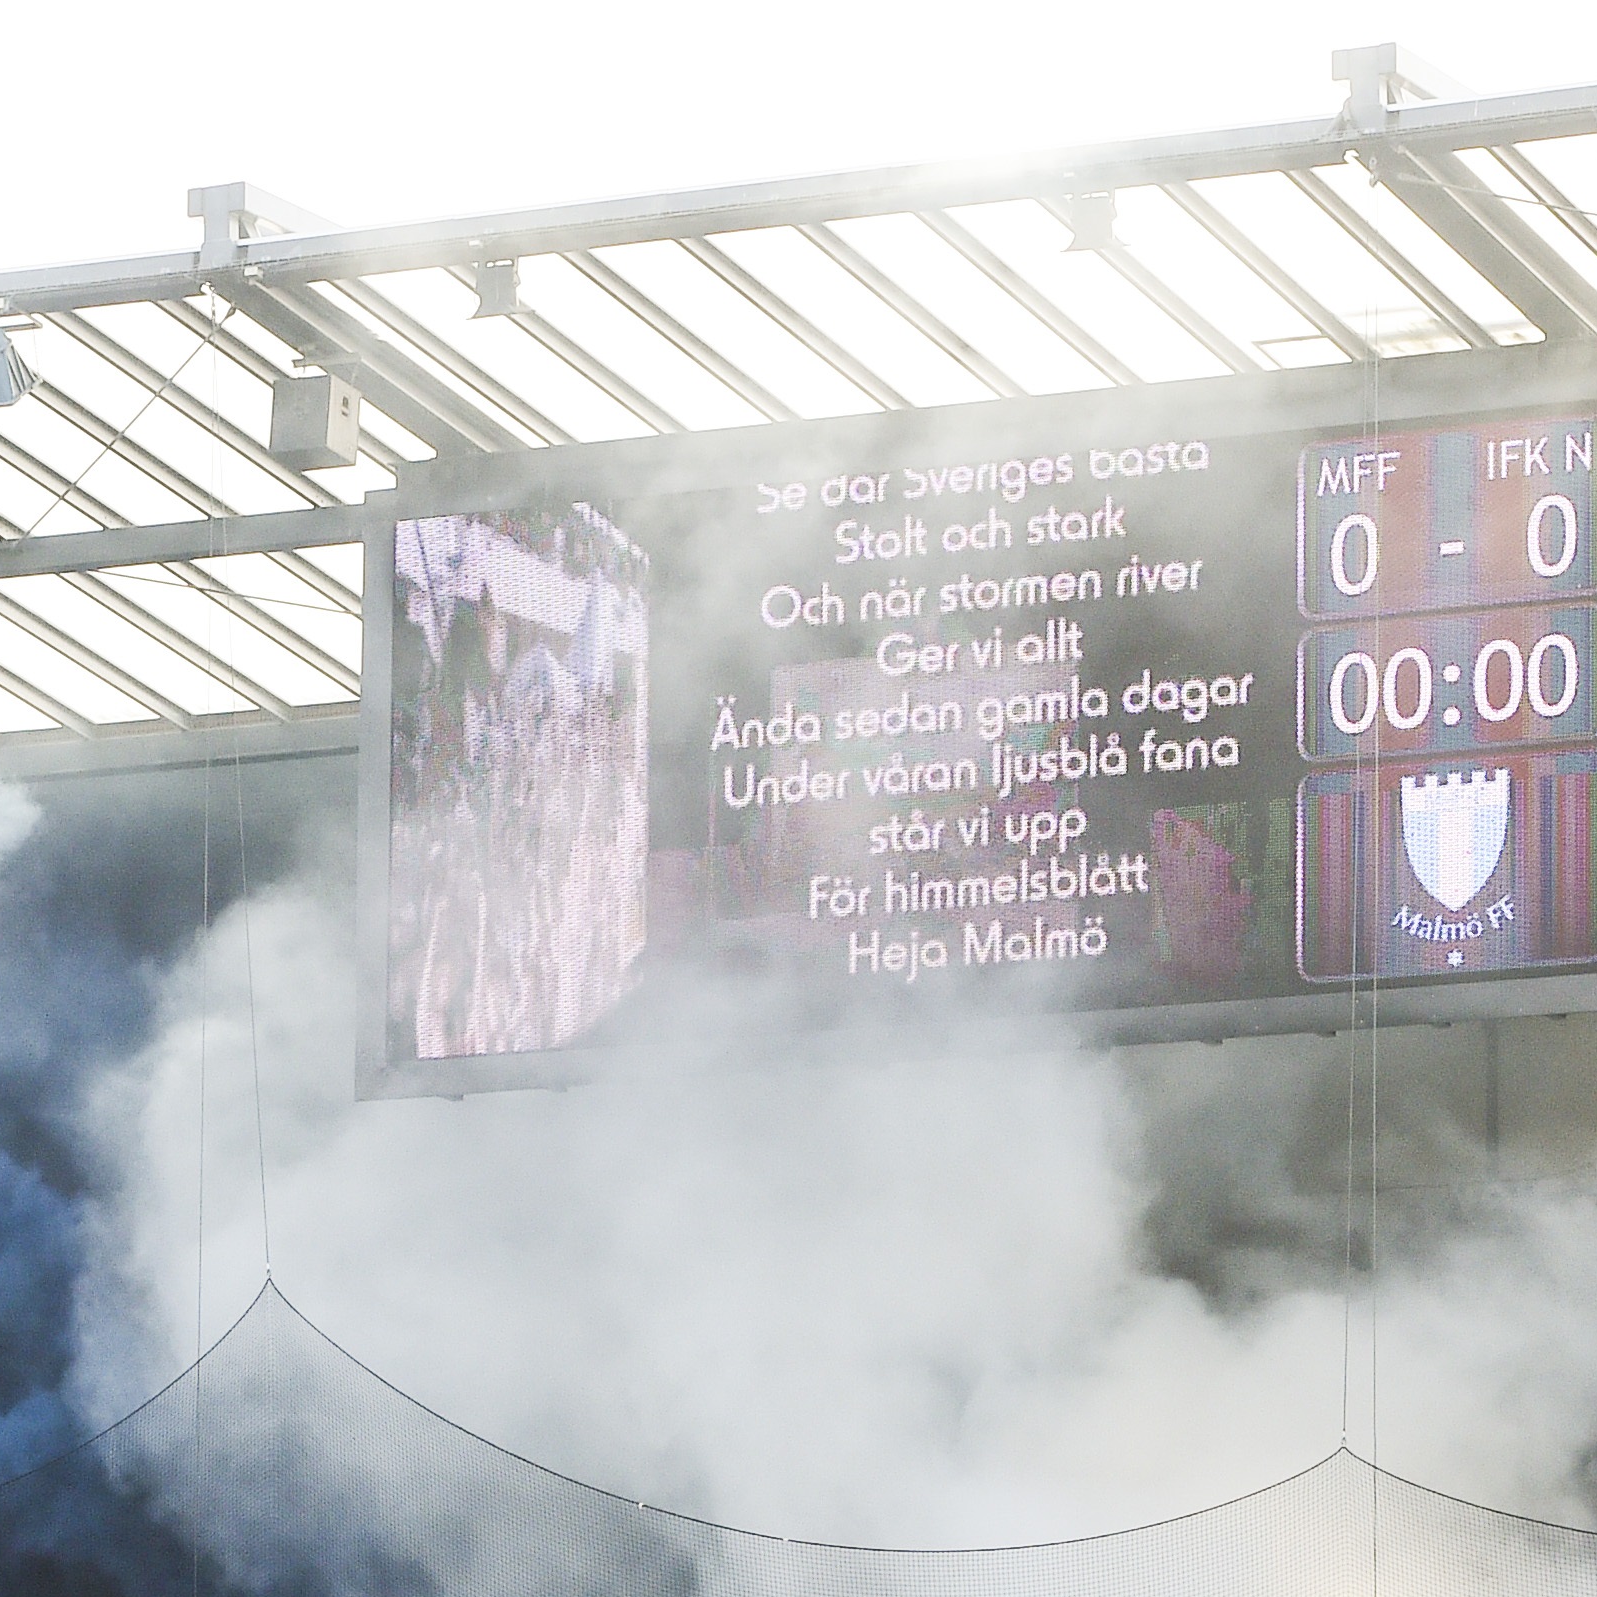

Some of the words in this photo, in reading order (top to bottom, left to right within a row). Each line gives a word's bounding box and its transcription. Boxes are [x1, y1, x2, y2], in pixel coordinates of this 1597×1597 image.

[1318, 452, 1401, 496] MFF
[1488, 438, 1549, 480] IFK
[1565, 432, 1592, 472] N
[835, 516, 928, 563] Stolt
[942, 507, 1012, 552] och
[1027, 496, 1126, 546] stark
[1330, 514, 1379, 596] 0
[1527, 494, 1578, 577] 0
[761, 583, 845, 628] Och
[860, 579, 926, 623] när
[939, 568, 1102, 614] stormen
[1117, 556, 1203, 597] river
[877, 633, 959, 676] Ger
[971, 629, 1002, 667] vi
[1017, 617, 1083, 661] allt
[712, 696, 820, 750] Ända
[835, 694, 962, 739] sedan
[978, 676, 1108, 741] gamla
[1123, 669, 1254, 722] dagar
[1329, 633, 1578, 734] 00:00
[724, 763, 850, 808] Under
[863, 753, 978, 797] våran
[992, 732, 1126, 797] ljusblå
[1140, 728, 1240, 772] fana
[869, 811, 945, 854] står
[958, 809, 989, 846] vi
[1004, 809, 1087, 856] upp
[809, 874, 871, 919] För
[884, 853, 1150, 913] himmelsblått
[1392, 906, 1484, 942] Malmö
[1486, 894, 1517, 928] FF
[849, 933, 948, 984] Heja
[963, 918, 1108, 967] Malmö
